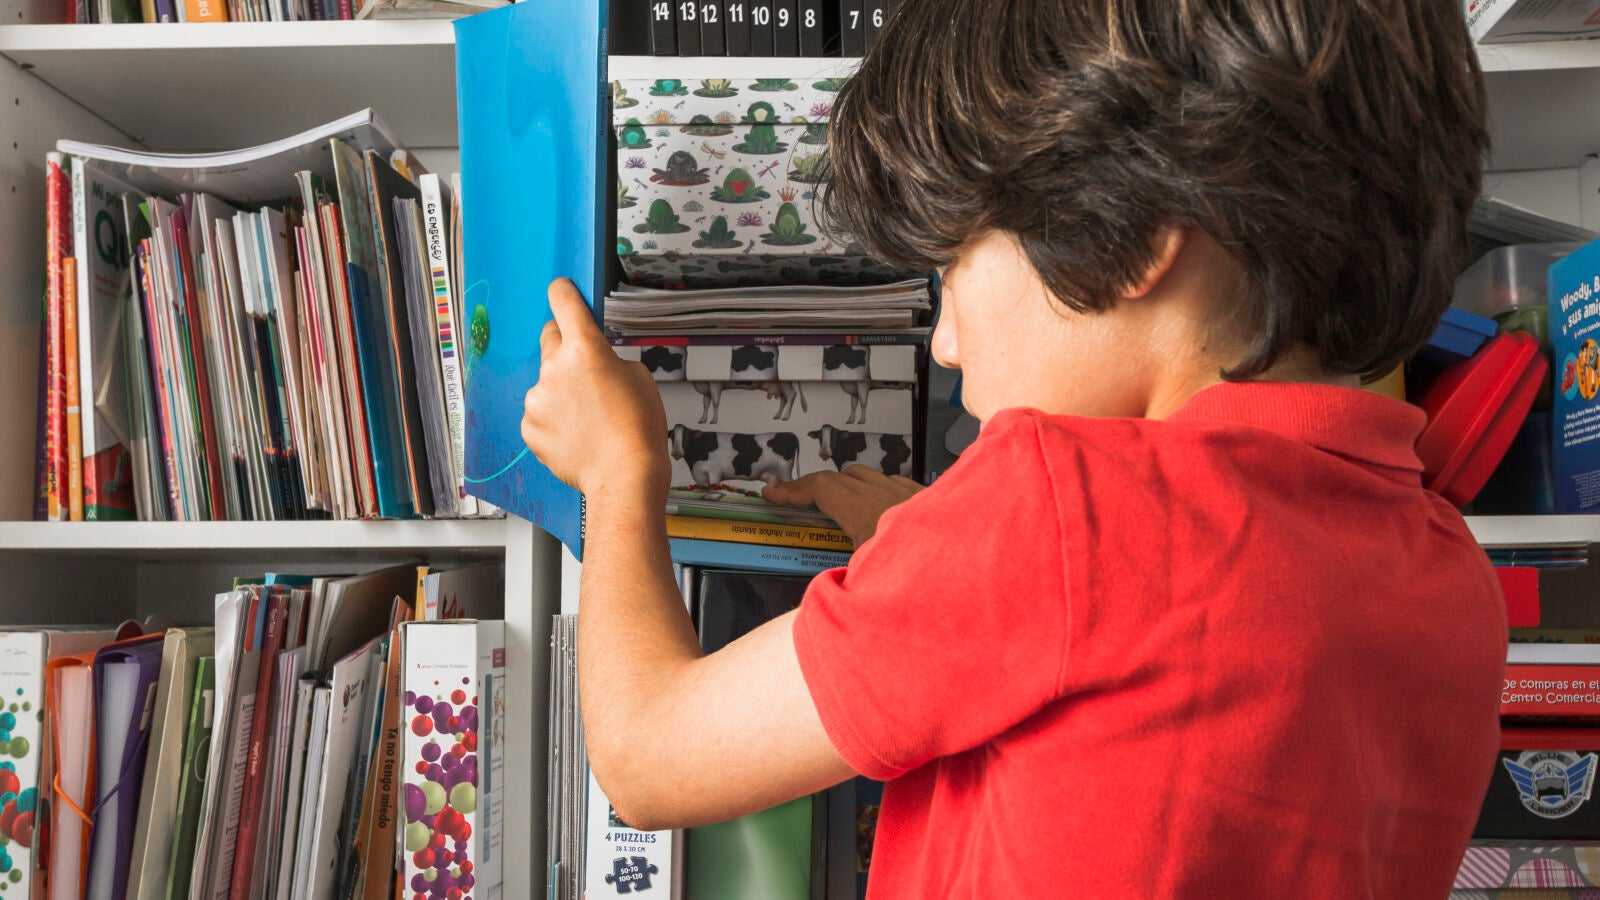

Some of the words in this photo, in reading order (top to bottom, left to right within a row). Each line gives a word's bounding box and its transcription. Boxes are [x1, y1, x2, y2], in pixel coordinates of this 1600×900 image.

[653, 2, 670, 21] 14
[680, 2, 696, 21] 13
[701, 5, 718, 24] 12
[729, 3, 744, 23] 11
[752, 6, 769, 26] 10
[778, 8, 789, 28] 9
[805, 8, 816, 28] 8
[849, 10, 860, 30] 7
[872, 8, 883, 28] 6
[427, 203, 436, 214] ED
[428, 216, 443, 261] EMBERLEY
[1562, 324, 1567, 336] y
[1567, 308, 1582, 328] sus
[445, 364, 456, 382] ¡Qué
[447, 382, 459, 401] fácil
[449, 401, 458, 411] es
[449, 412, 463, 439] dibujar
[731, 525, 757, 535] Martín
[759, 528, 783, 538] Muñoz
[785, 529, 801, 540] Juan
[1520, 680, 1569, 690] compras
[1572, 680, 1586, 689] en
[1501, 692, 1543, 704] Centro
[387, 727, 399, 739] Ya
[386, 742, 396, 757] no
[1530, 751, 1565, 763] BLUE
[379, 759, 394, 791] tengo
[377, 794, 391, 829] miedo
[1531, 801, 1574, 815] LEADER
[605, 833, 612, 842] 4
[614, 833, 656, 843] PUZZLES
